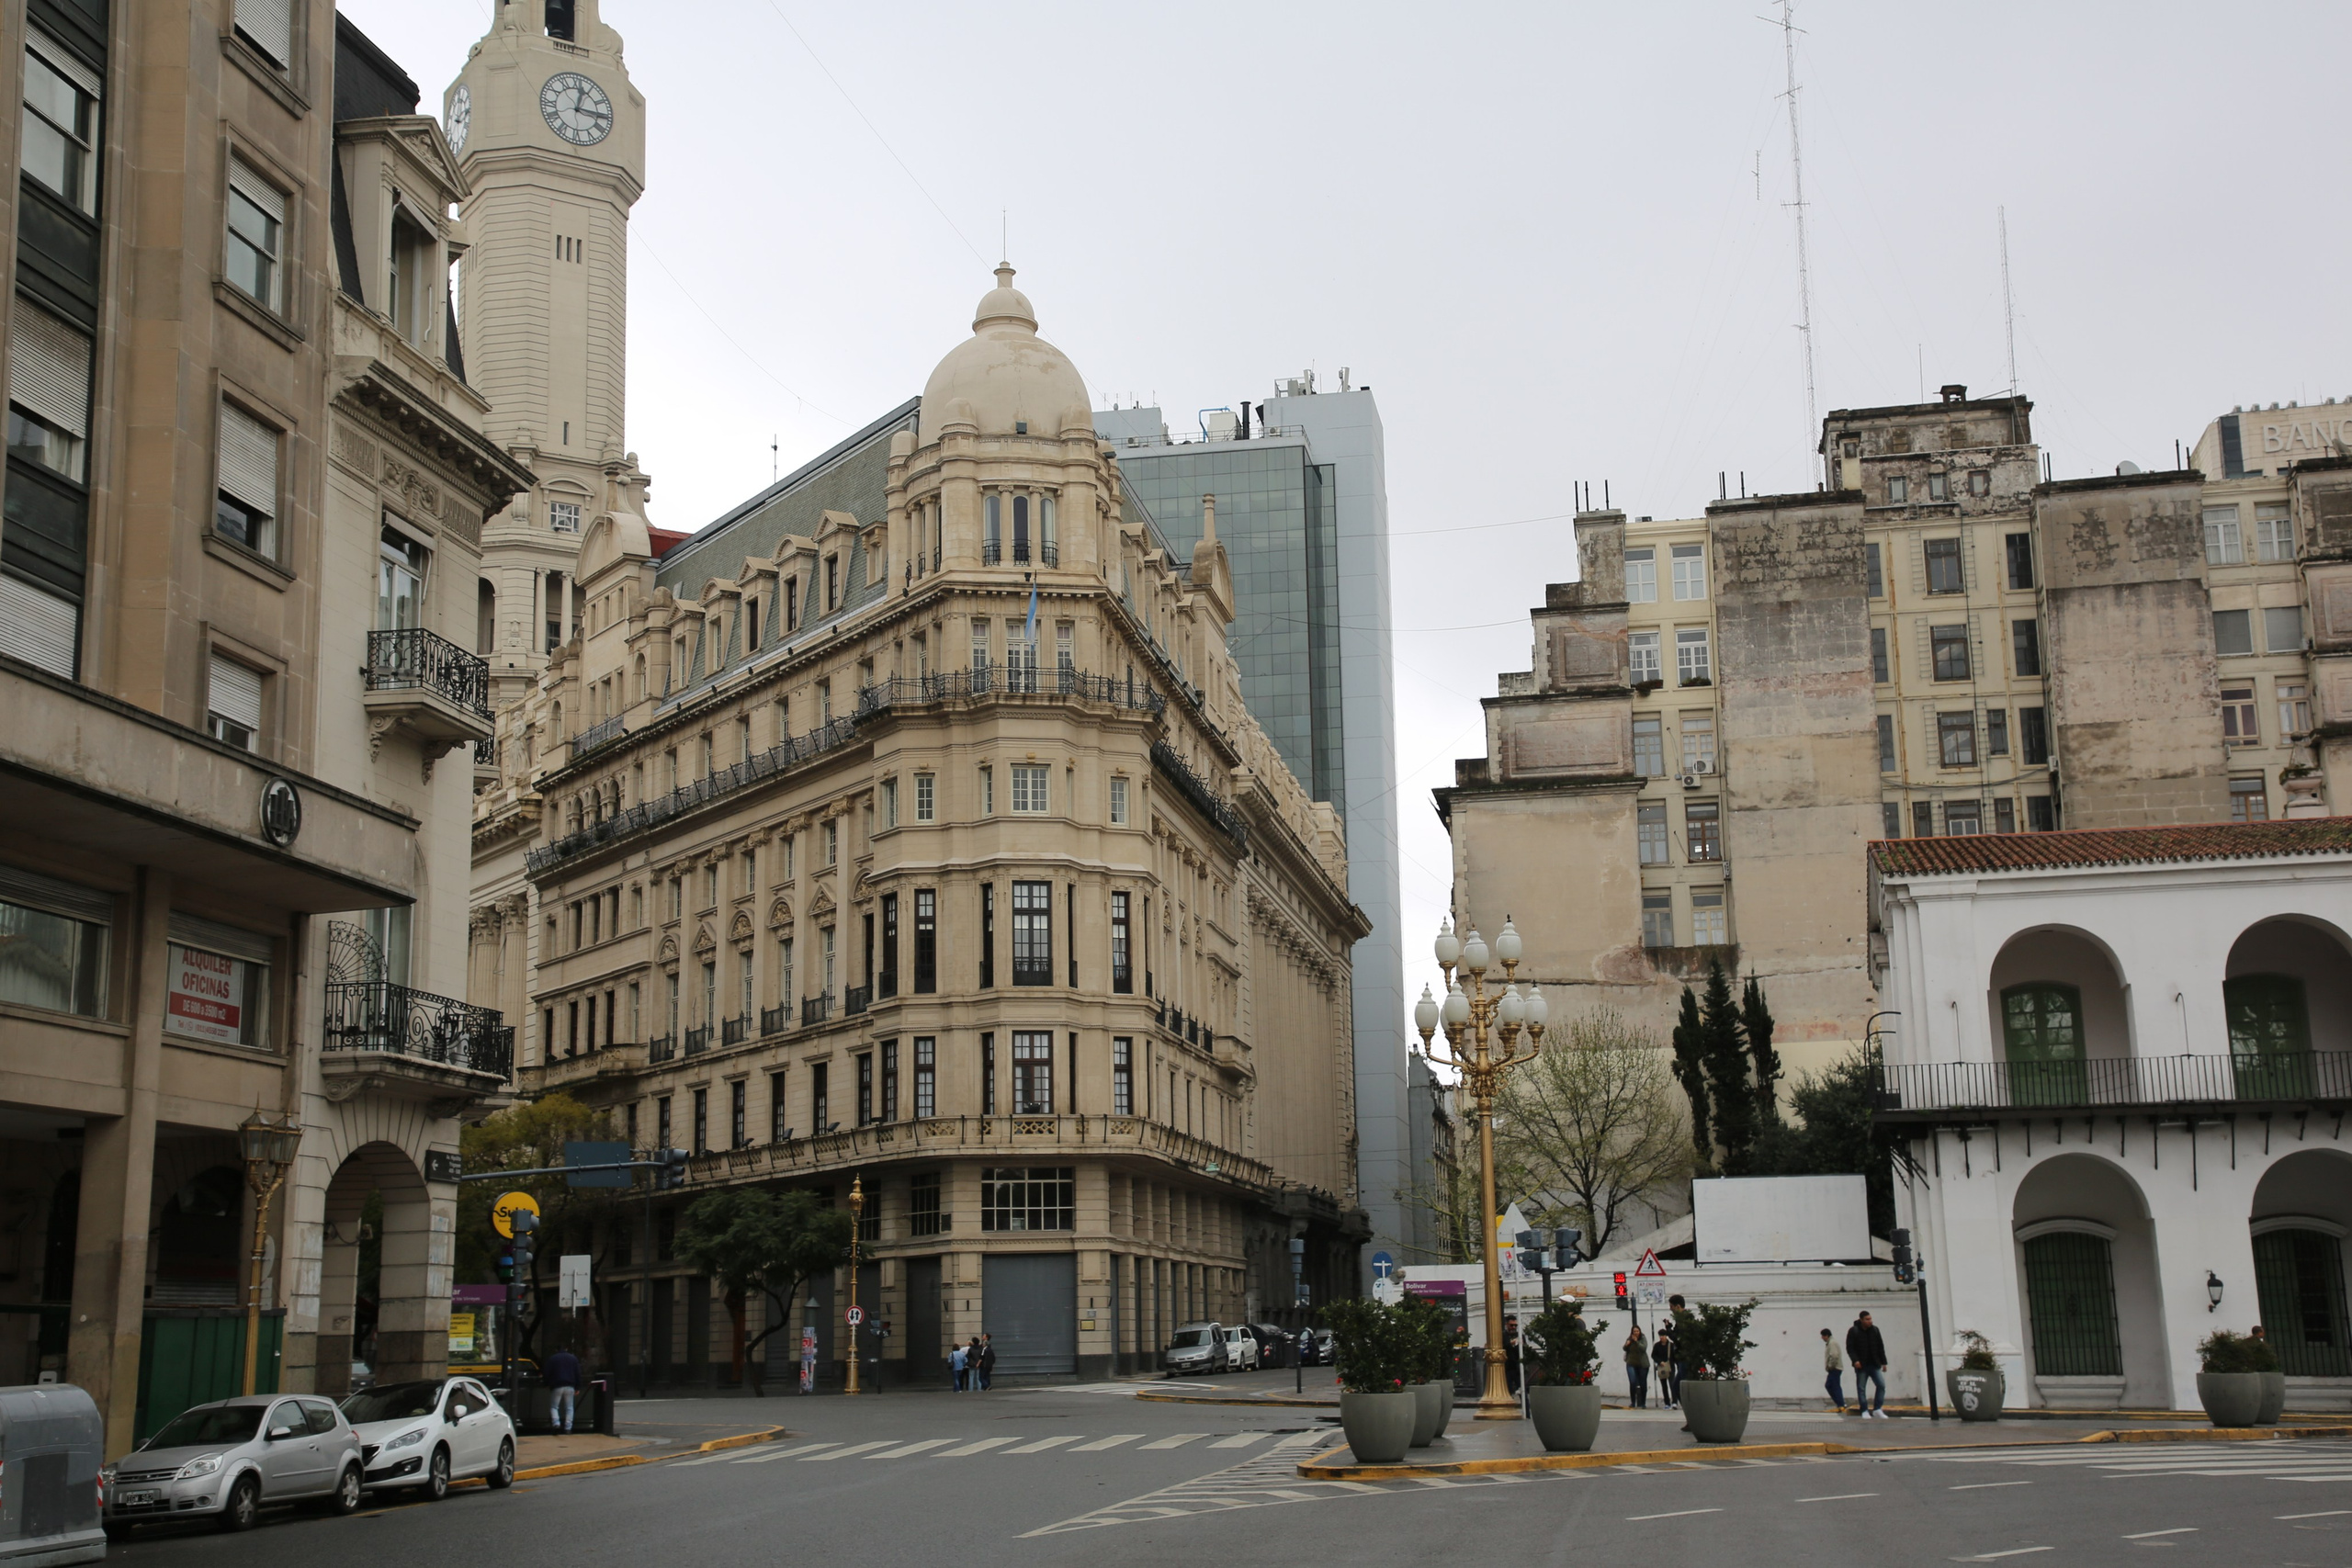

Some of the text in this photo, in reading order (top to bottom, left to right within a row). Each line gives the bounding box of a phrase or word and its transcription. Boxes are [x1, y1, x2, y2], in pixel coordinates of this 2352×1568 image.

[182, 948, 232, 976] ALQUILER
[182, 971, 230, 998] OFICINAS
[183, 999, 190, 1012] DE
